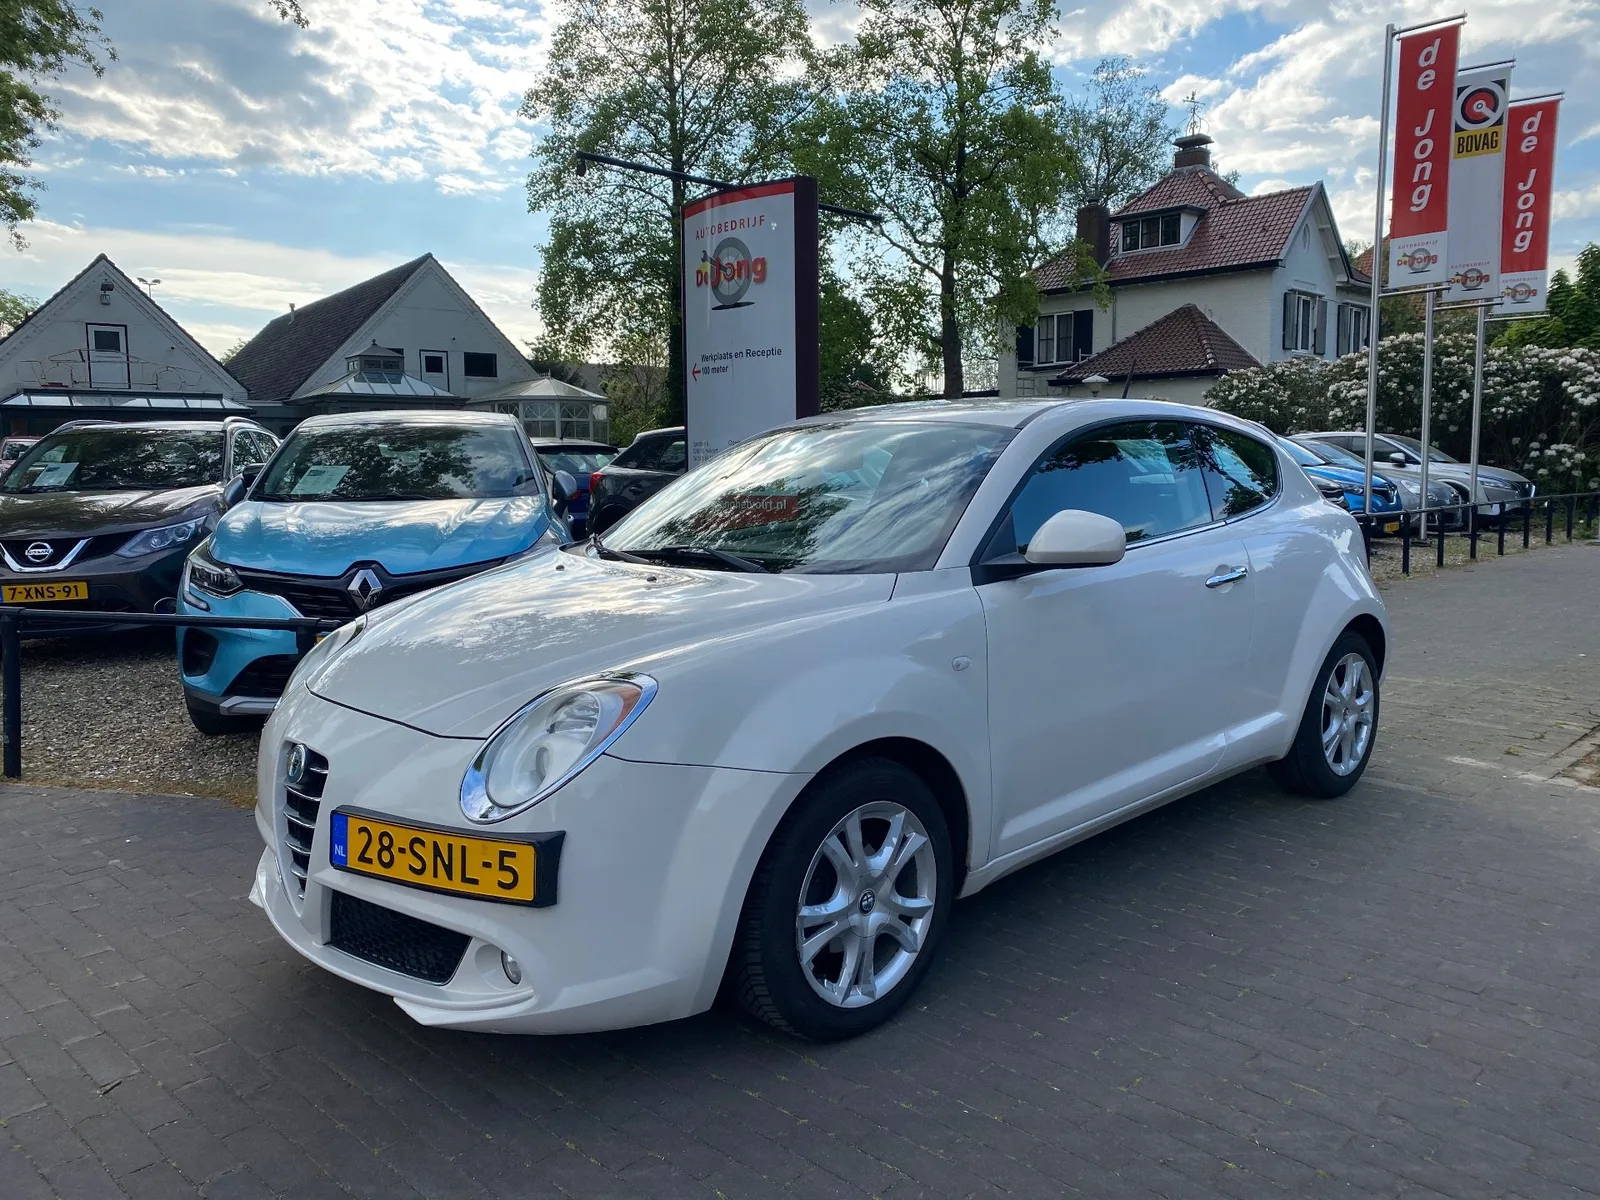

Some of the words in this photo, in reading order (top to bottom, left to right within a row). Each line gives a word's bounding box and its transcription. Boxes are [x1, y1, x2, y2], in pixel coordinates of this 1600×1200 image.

[1417, 38, 1441, 91] de
[1456, 130, 1499, 154] BOVAG
[1520, 110, 1543, 153] de
[1410, 108, 1435, 212] Jong
[1513, 168, 1537, 253] Jong
[695, 214, 766, 241] AUTOBEDRIJF
[701, 351, 733, 363] Werkplaats
[734, 350, 744, 359] en
[745, 346, 782, 359] Receptie
[701, 366, 711, 375] 100
[711, 365, 729, 374] meter
[8, 584, 79, 601] 7-XNS-91
[334, 843, 346, 858] NL
[357, 826, 519, 891] 28-SNL-5
